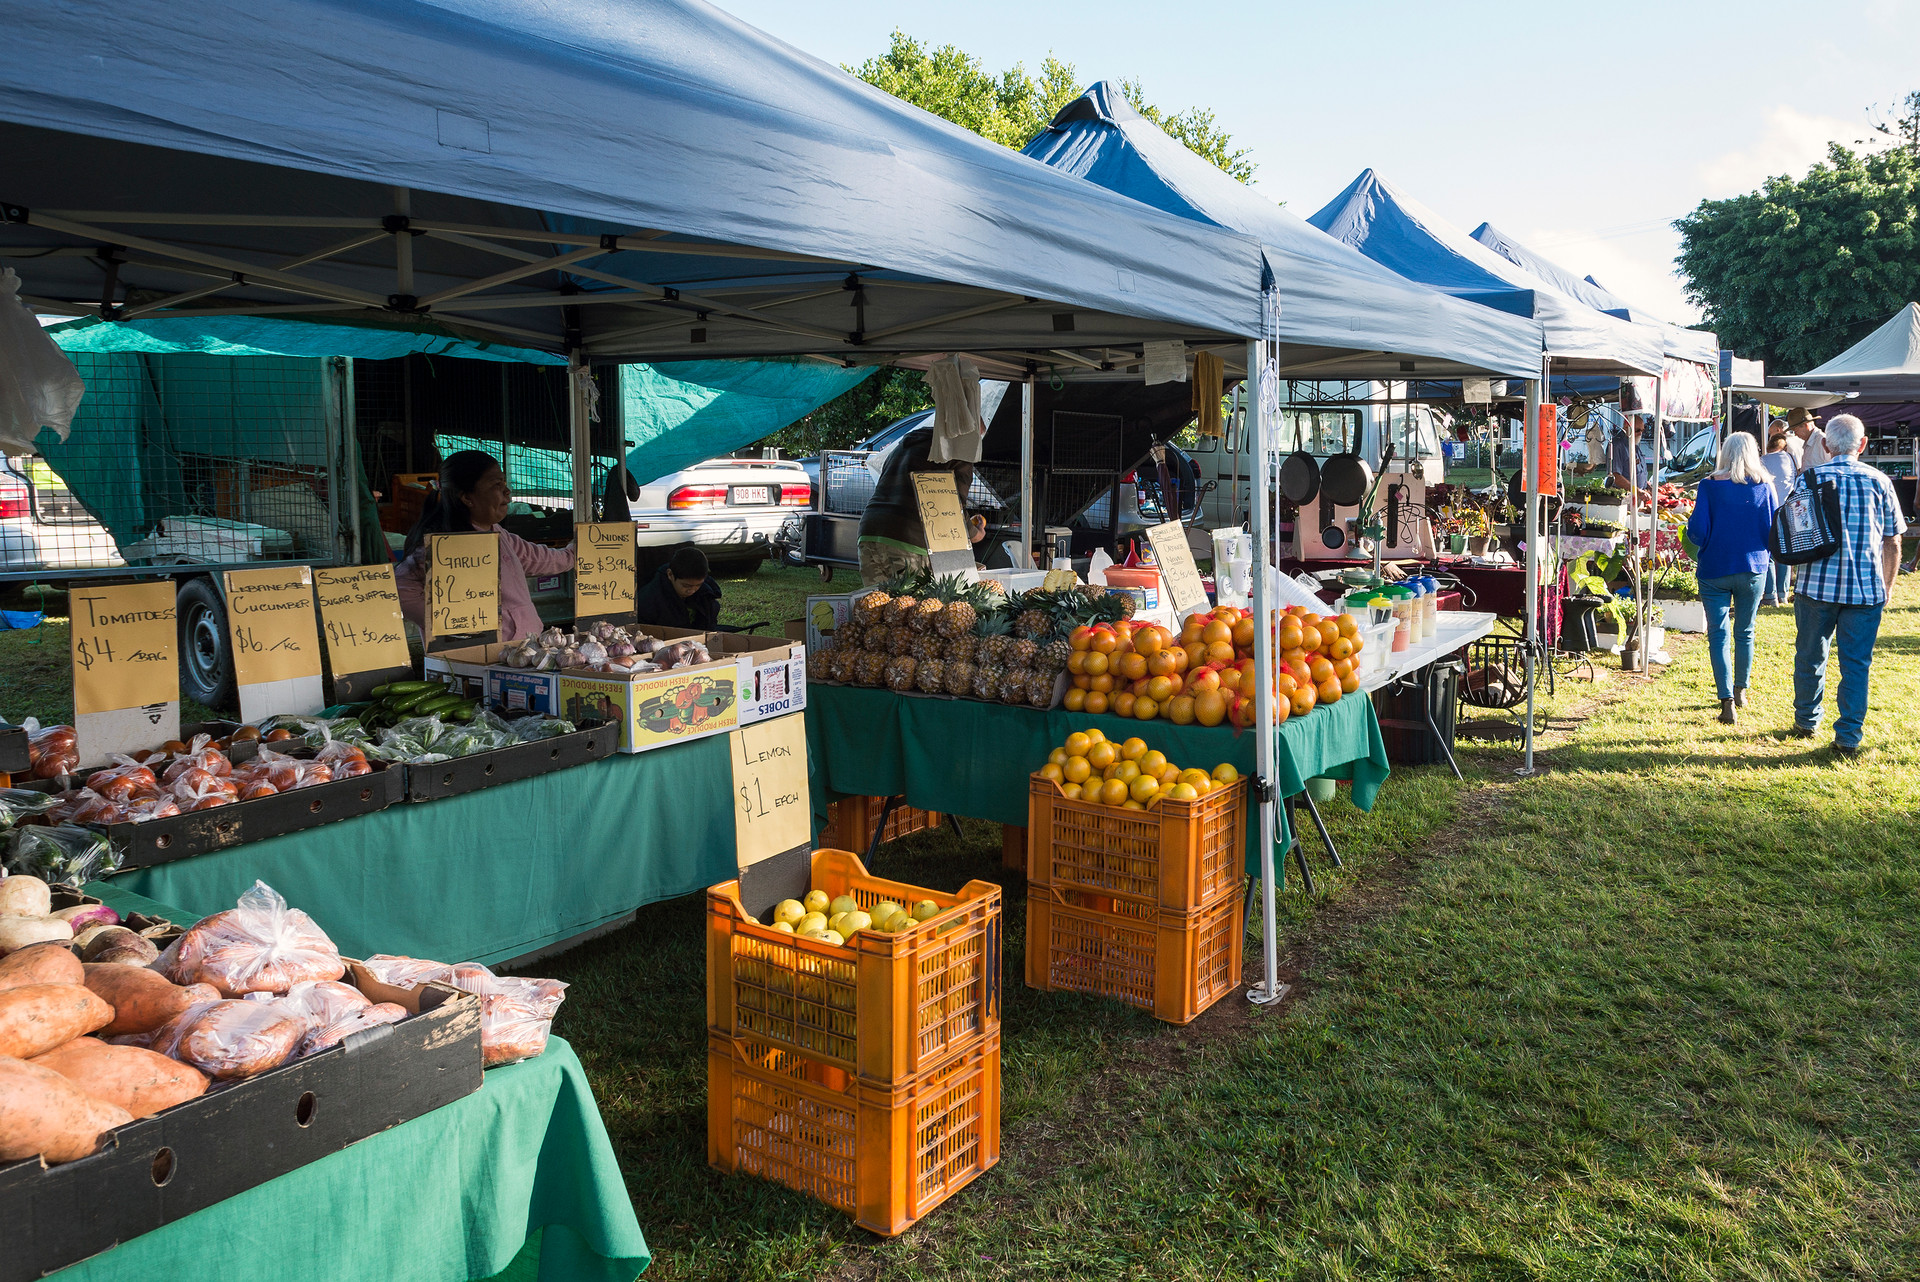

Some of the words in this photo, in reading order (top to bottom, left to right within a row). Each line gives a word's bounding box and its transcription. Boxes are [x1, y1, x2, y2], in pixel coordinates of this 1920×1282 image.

[736, 489, 749, 499] 908
[751, 489, 766, 498] HKE
[589, 525, 629, 543] ONIONS
[436, 536, 492, 569] GARLIC
[578, 557, 594, 570] RED
[352, 583, 360, 591] &
[320, 594, 353, 606] SUGAR
[479, 590, 494, 598] EACH
[233, 596, 310, 614] CUCUMBER
[79, 597, 176, 627] TOMATOES
[562, 679, 597, 691] PRODUCE
[635, 680, 668, 692] PRODUCE
[670, 676, 690, 686] FRESH
[598, 683, 623, 693] FRESH
[758, 699, 790, 716] DOBES
[687, 721, 713, 734] PRODUCE
[713, 717, 737, 729] FRESH
[740, 730, 791, 765] LEMON
[775, 792, 799, 807] EACH
